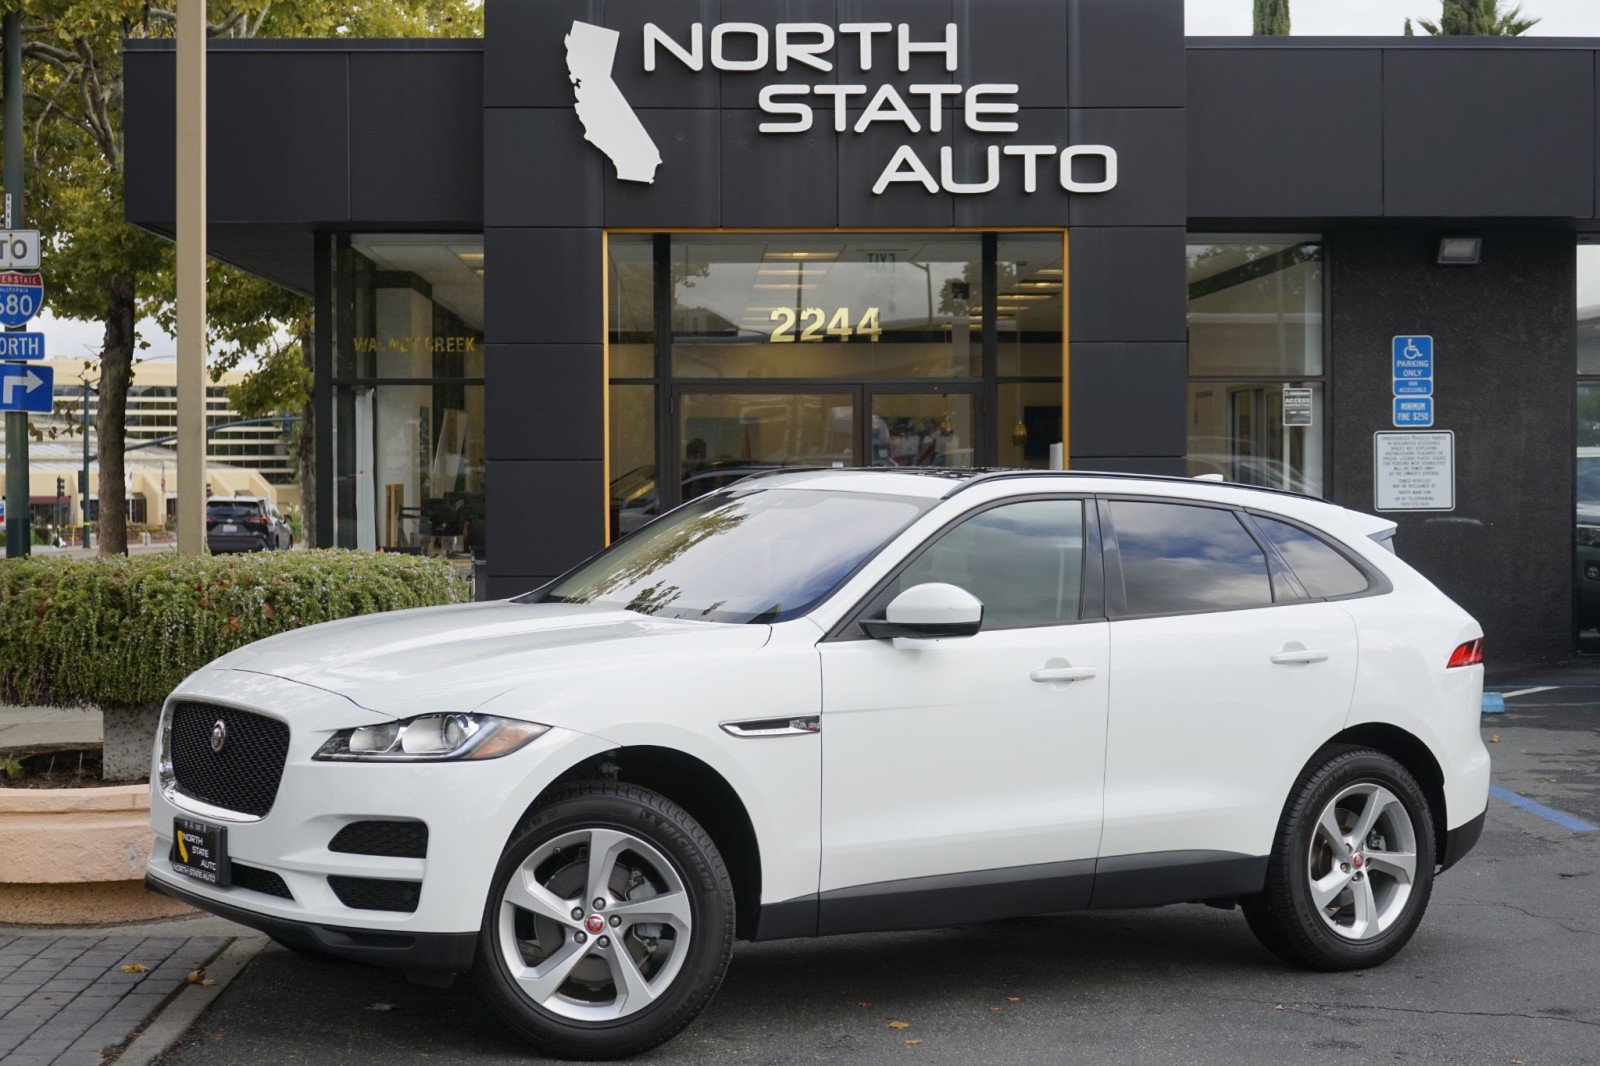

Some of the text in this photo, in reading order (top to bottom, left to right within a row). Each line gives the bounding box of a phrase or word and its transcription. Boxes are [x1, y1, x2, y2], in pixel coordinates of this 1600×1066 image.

[642, 21, 959, 72] NORTH
[757, 82, 1020, 133] STATE
[872, 144, 1118, 194] AUTO
[0, 239, 27, 259] TO
[770, 306, 883, 343] 2244
[425, 337, 476, 352] CREEK
[182, 832, 203, 846] NORTH
[192, 846, 209, 858] STATE
[658, 822, 715, 890] MICHELIN
[189, 868, 202, 878] STATE
